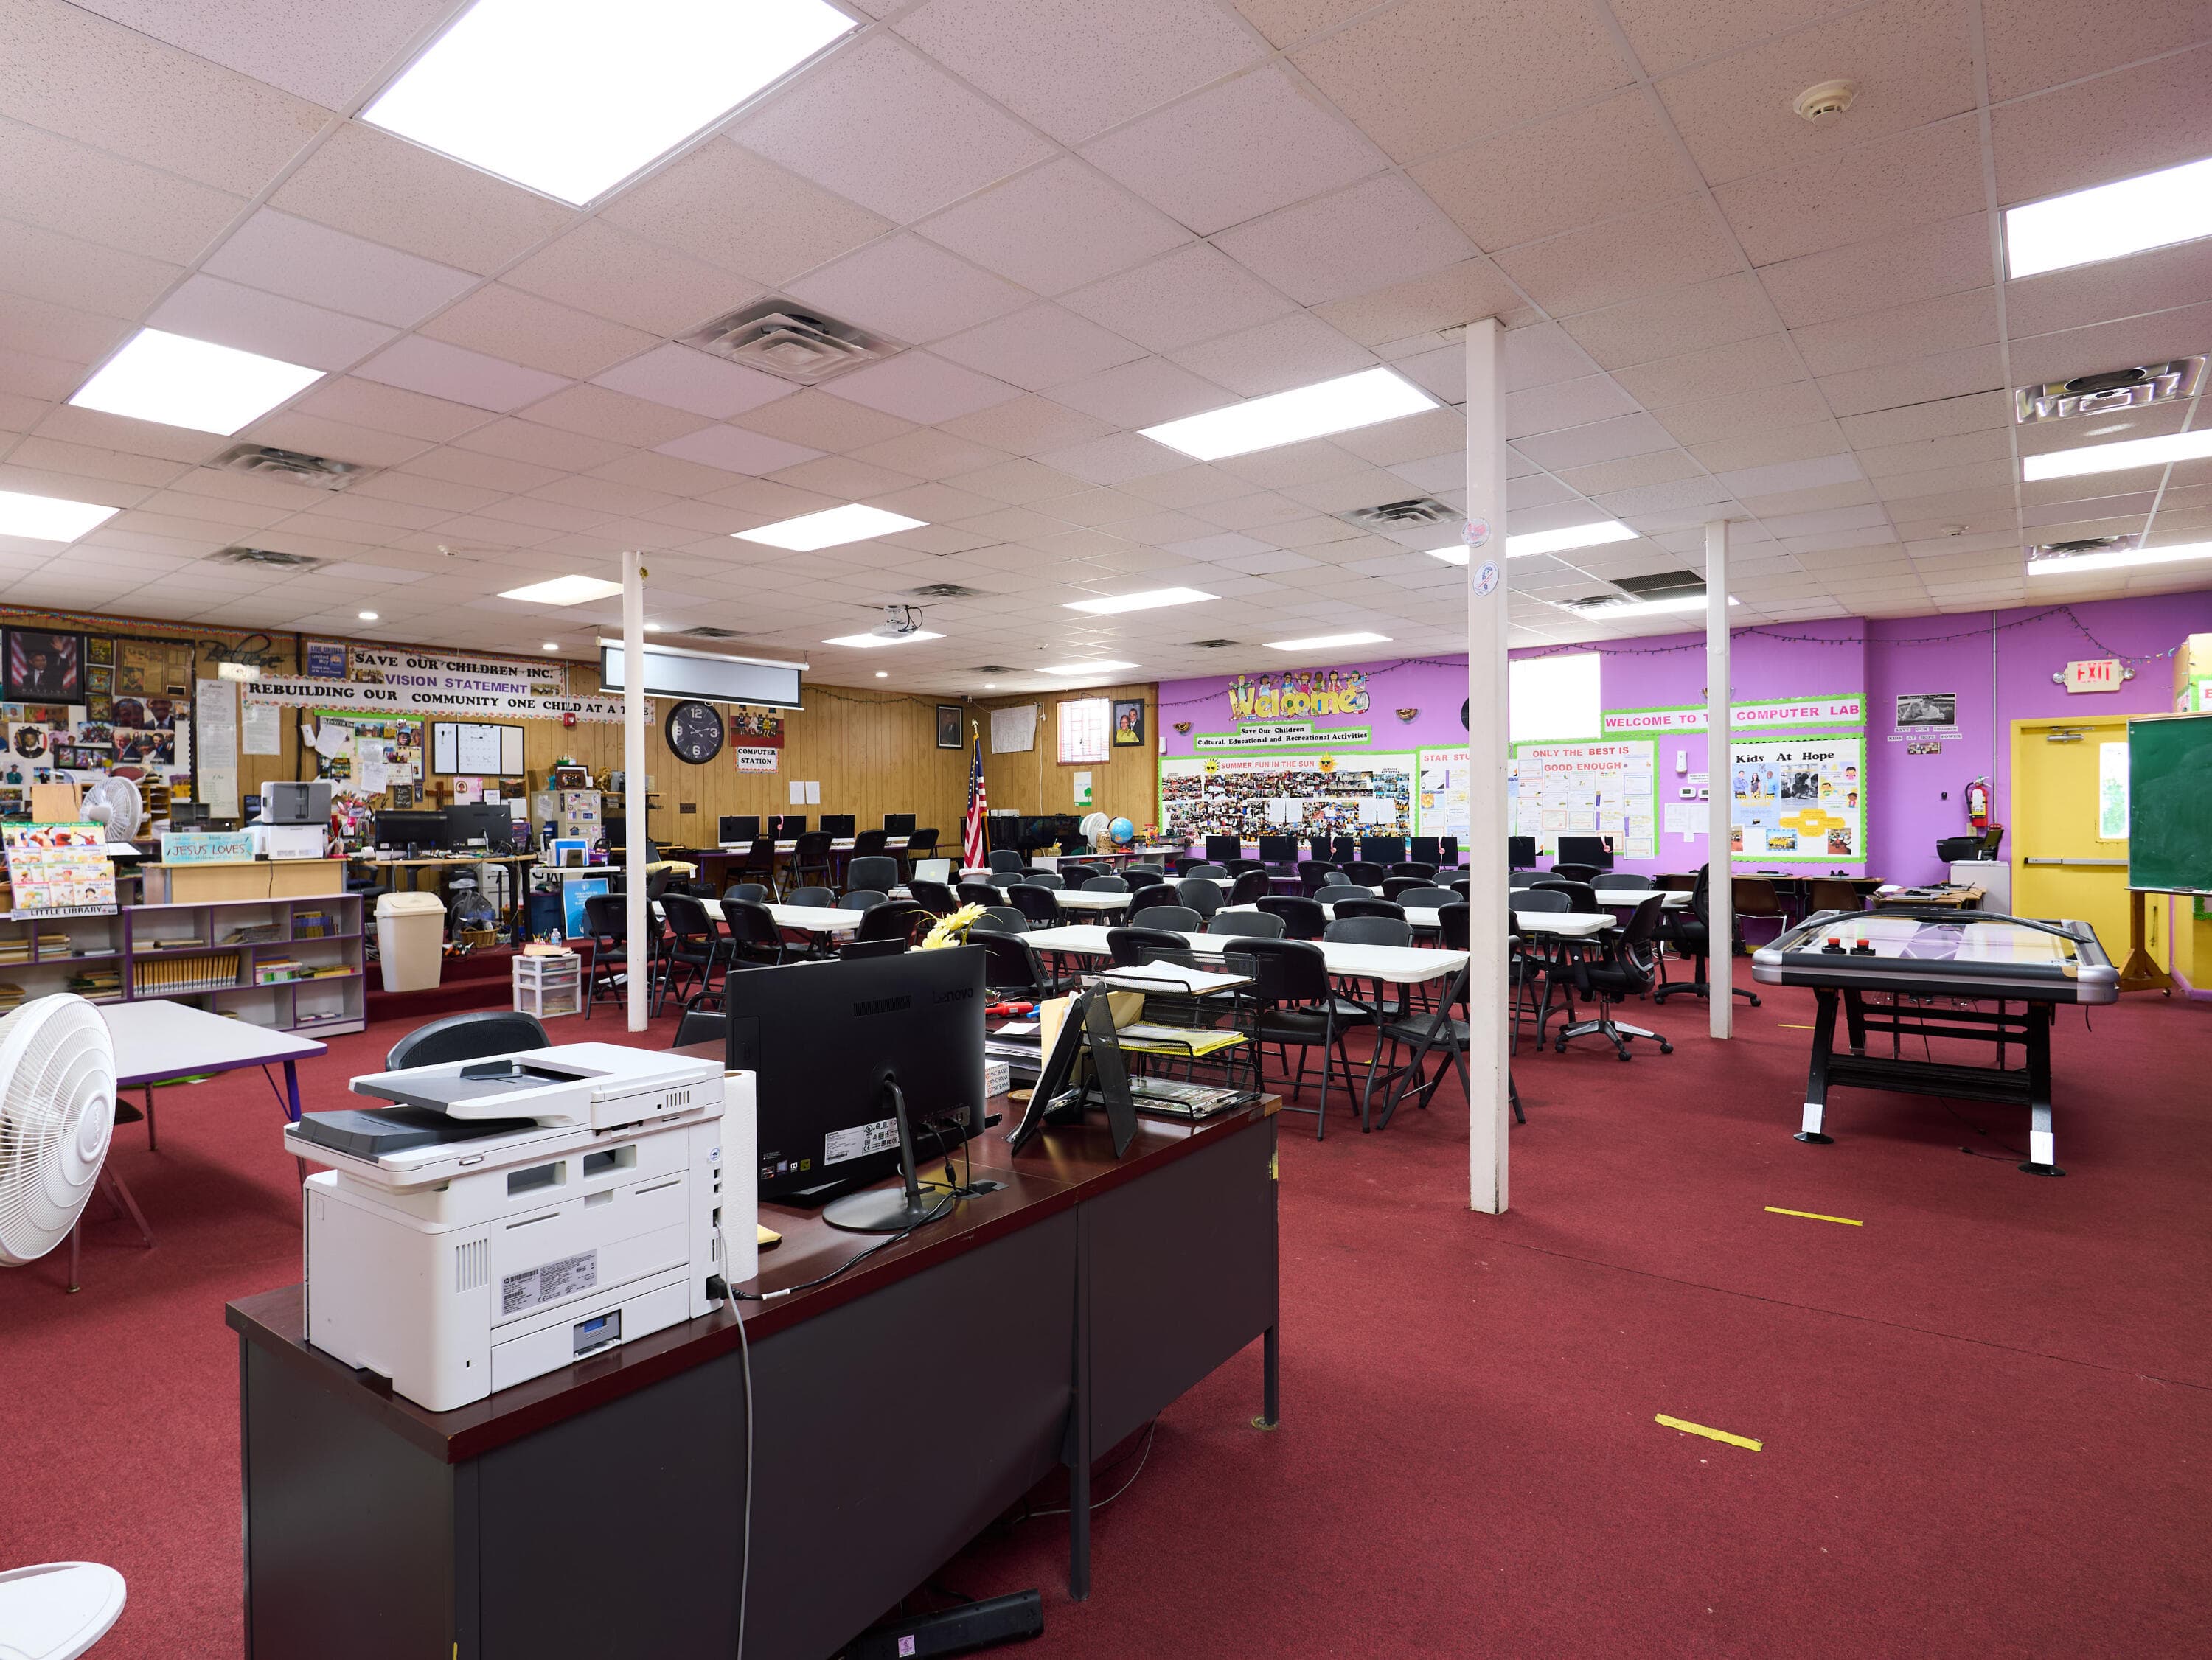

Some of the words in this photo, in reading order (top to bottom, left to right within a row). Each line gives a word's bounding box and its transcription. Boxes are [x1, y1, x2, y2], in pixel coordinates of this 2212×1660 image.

[323, 646, 343, 654] UNITED
[355, 653, 398, 667] SAVE
[406, 658, 439, 670] OUR
[446, 662, 518, 677] CHILDREN
[526, 668, 553, 679] INC.
[2077, 662, 2112, 683] EXIT
[384, 674, 437, 687] VISION
[445, 678, 528, 694] STATEMENT
[248, 683, 355, 698] REBUILDING
[364, 689, 397, 700] OUR
[411, 693, 499, 707] COMMUNITY
[507, 699, 535, 709] ONE
[543, 701, 582, 712] CHILD
[585, 704, 602, 713] AT
[607, 705, 616, 714] A
[620, 705, 649, 716] TE
[1228, 686, 1359, 719] Welcome
[690, 708, 703, 719] 12
[1736, 706, 1820, 721] COMPUTER
[1830, 704, 1860, 716] LAB
[1605, 716, 1672, 728] WELCOME
[1679, 714, 1697, 724] TO
[710, 728, 717, 737] 3
[1274, 726, 1304, 734] Children
[1197, 739, 1226, 747] Cultural,
[1286, 734, 1330, 742] Recreational
[1332, 732, 1368, 740] Activities
[692, 745, 700, 756] 6
[1532, 749, 1559, 758] ONLY
[1563, 749, 1583, 757] THE
[1588, 747, 1615, 756] BEST
[1619, 747, 1630, 755] IS
[1424, 754, 1448, 762] STAR
[1736, 754, 1764, 764] Kids
[1776, 753, 1792, 761] At
[1801, 752, 1834, 762] Hope
[1544, 764, 1573, 772] GOOD
[1577, 762, 1621, 770] ENOUGH
[172, 845, 207, 856] JESUS
[212, 844, 246, 855] LOVES
[30, 908, 60, 916] LITTLE
[63, 906, 102, 915] LIBRARY
[933, 988, 974, 1004] Lenovo
